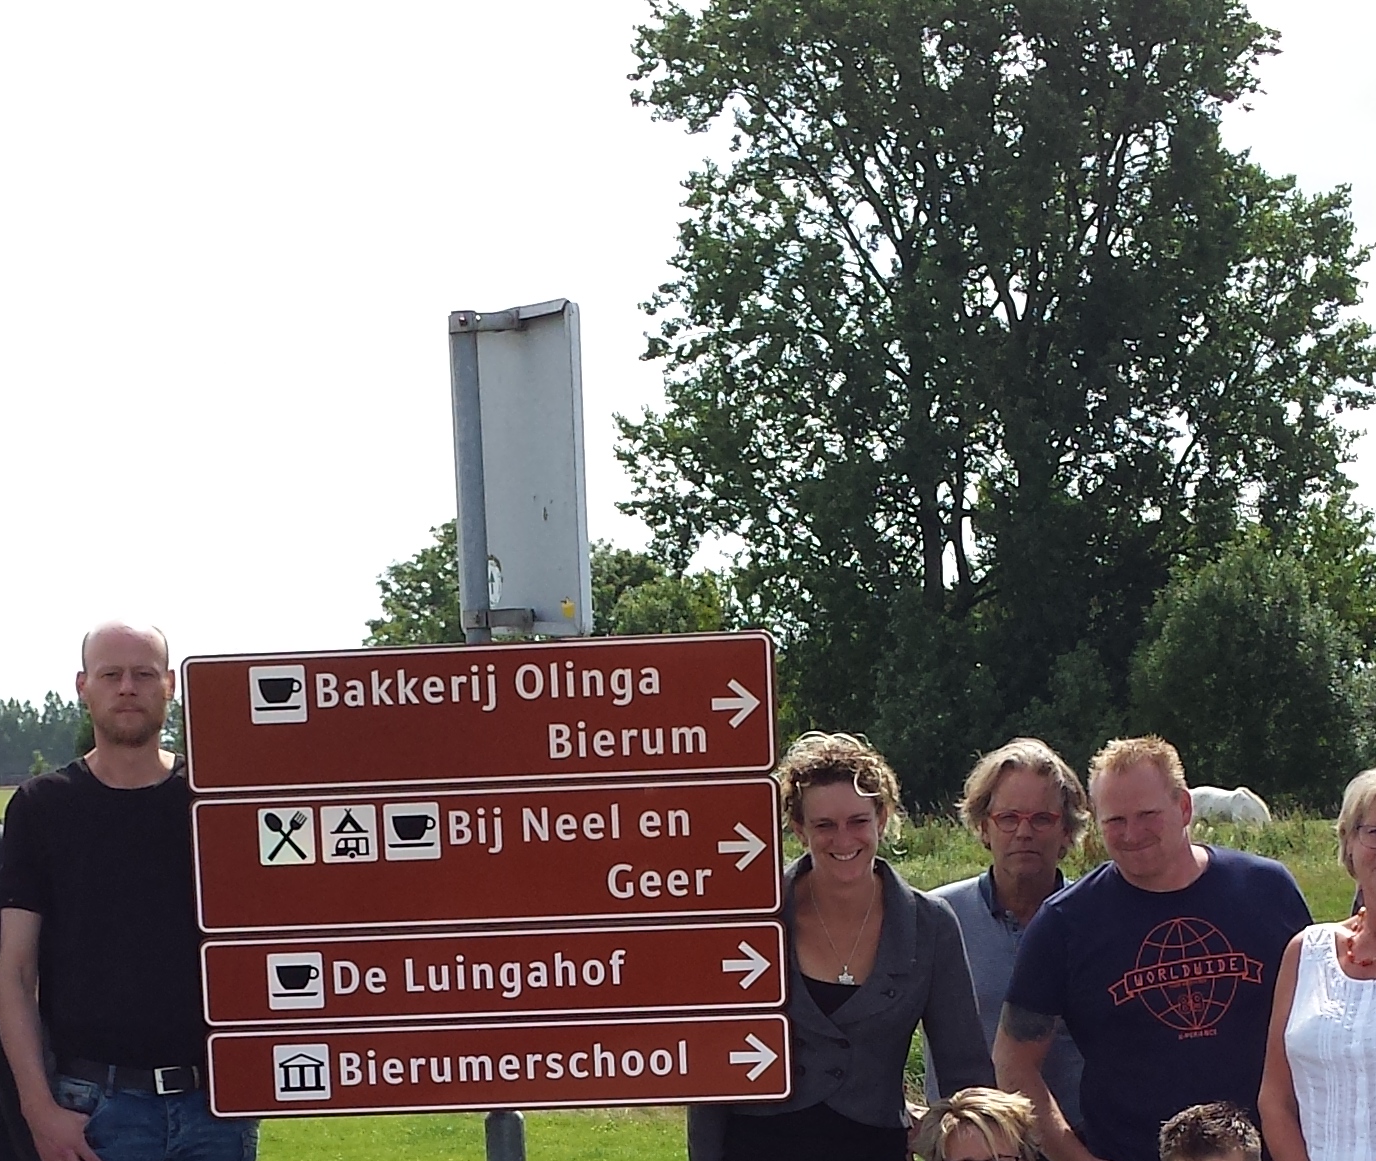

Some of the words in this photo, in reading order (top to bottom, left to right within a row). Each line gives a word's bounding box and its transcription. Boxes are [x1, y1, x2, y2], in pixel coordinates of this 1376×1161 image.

[315, 664, 497, 712] Bakkerij
[515, 660, 660, 706] Olinga
[548, 721, 707, 759] Bierum
[448, 807, 503, 854] Bij
[522, 803, 620, 842] Neel
[639, 809, 690, 838] en
[607, 863, 712, 899] Geer
[332, 960, 387, 995] De
[404, 949, 626, 999] Luingahof
[1133, 957, 1239, 987] WORLDWIDE
[339, 1039, 688, 1086] Bierumerschool
